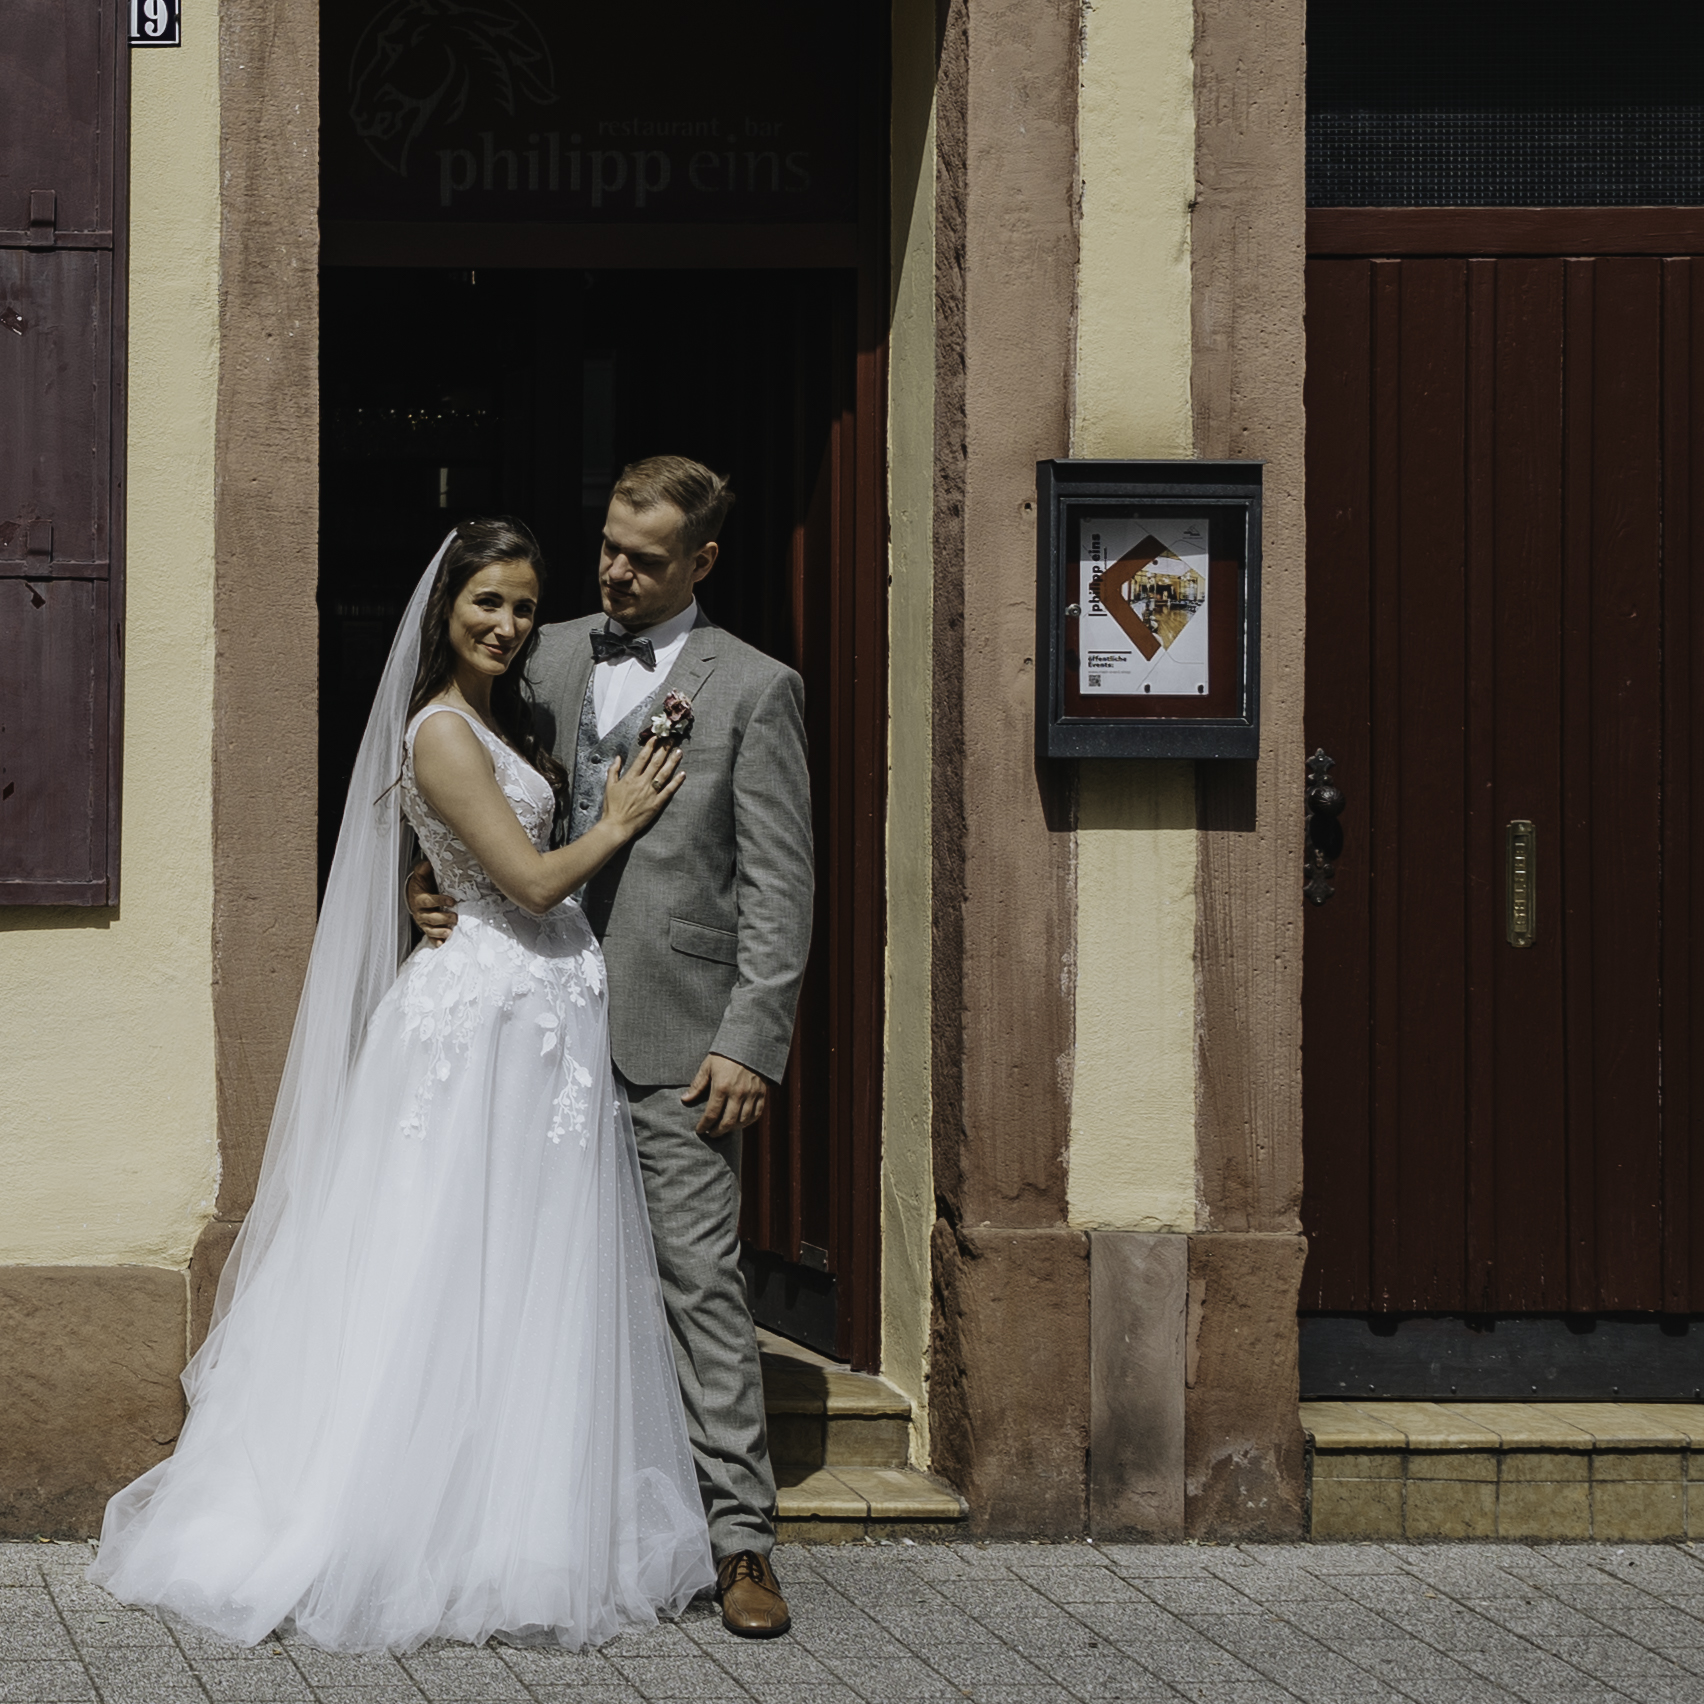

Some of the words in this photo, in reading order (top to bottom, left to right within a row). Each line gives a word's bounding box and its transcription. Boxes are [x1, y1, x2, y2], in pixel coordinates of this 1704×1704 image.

[598, 117, 720, 137] restaurant
[744, 116, 784, 137] bar
[436, 133, 672, 207] philipp
[689, 134, 813, 193] eins
[1088, 533, 1101, 562] eins
[1088, 565, 1103, 612] philipp
